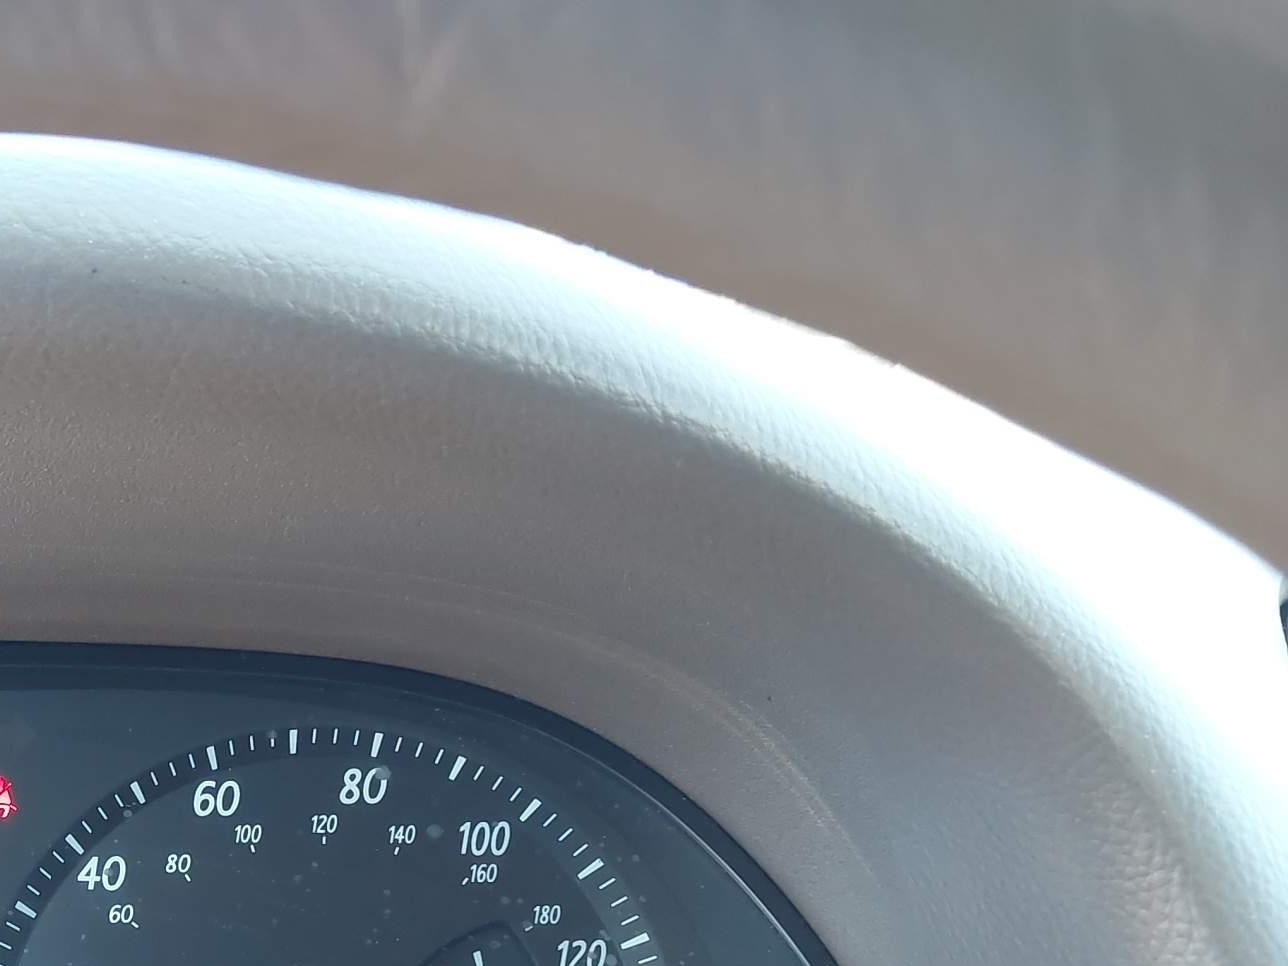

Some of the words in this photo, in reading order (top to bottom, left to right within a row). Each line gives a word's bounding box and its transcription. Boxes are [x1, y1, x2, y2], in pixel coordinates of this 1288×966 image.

[339, 767, 388, 804] 80
[192, 780, 241, 817] 60
[234, 824, 262, 844] 100
[312, 814, 338, 834] 120
[388, 825, 416, 844] 140
[459, 820, 510, 857] 100
[77, 855, 127, 891] 40
[165, 854, 191, 874] 80
[469, 864, 498, 883] 160
[109, 904, 134, 924] 60
[532, 905, 561, 924] 180
